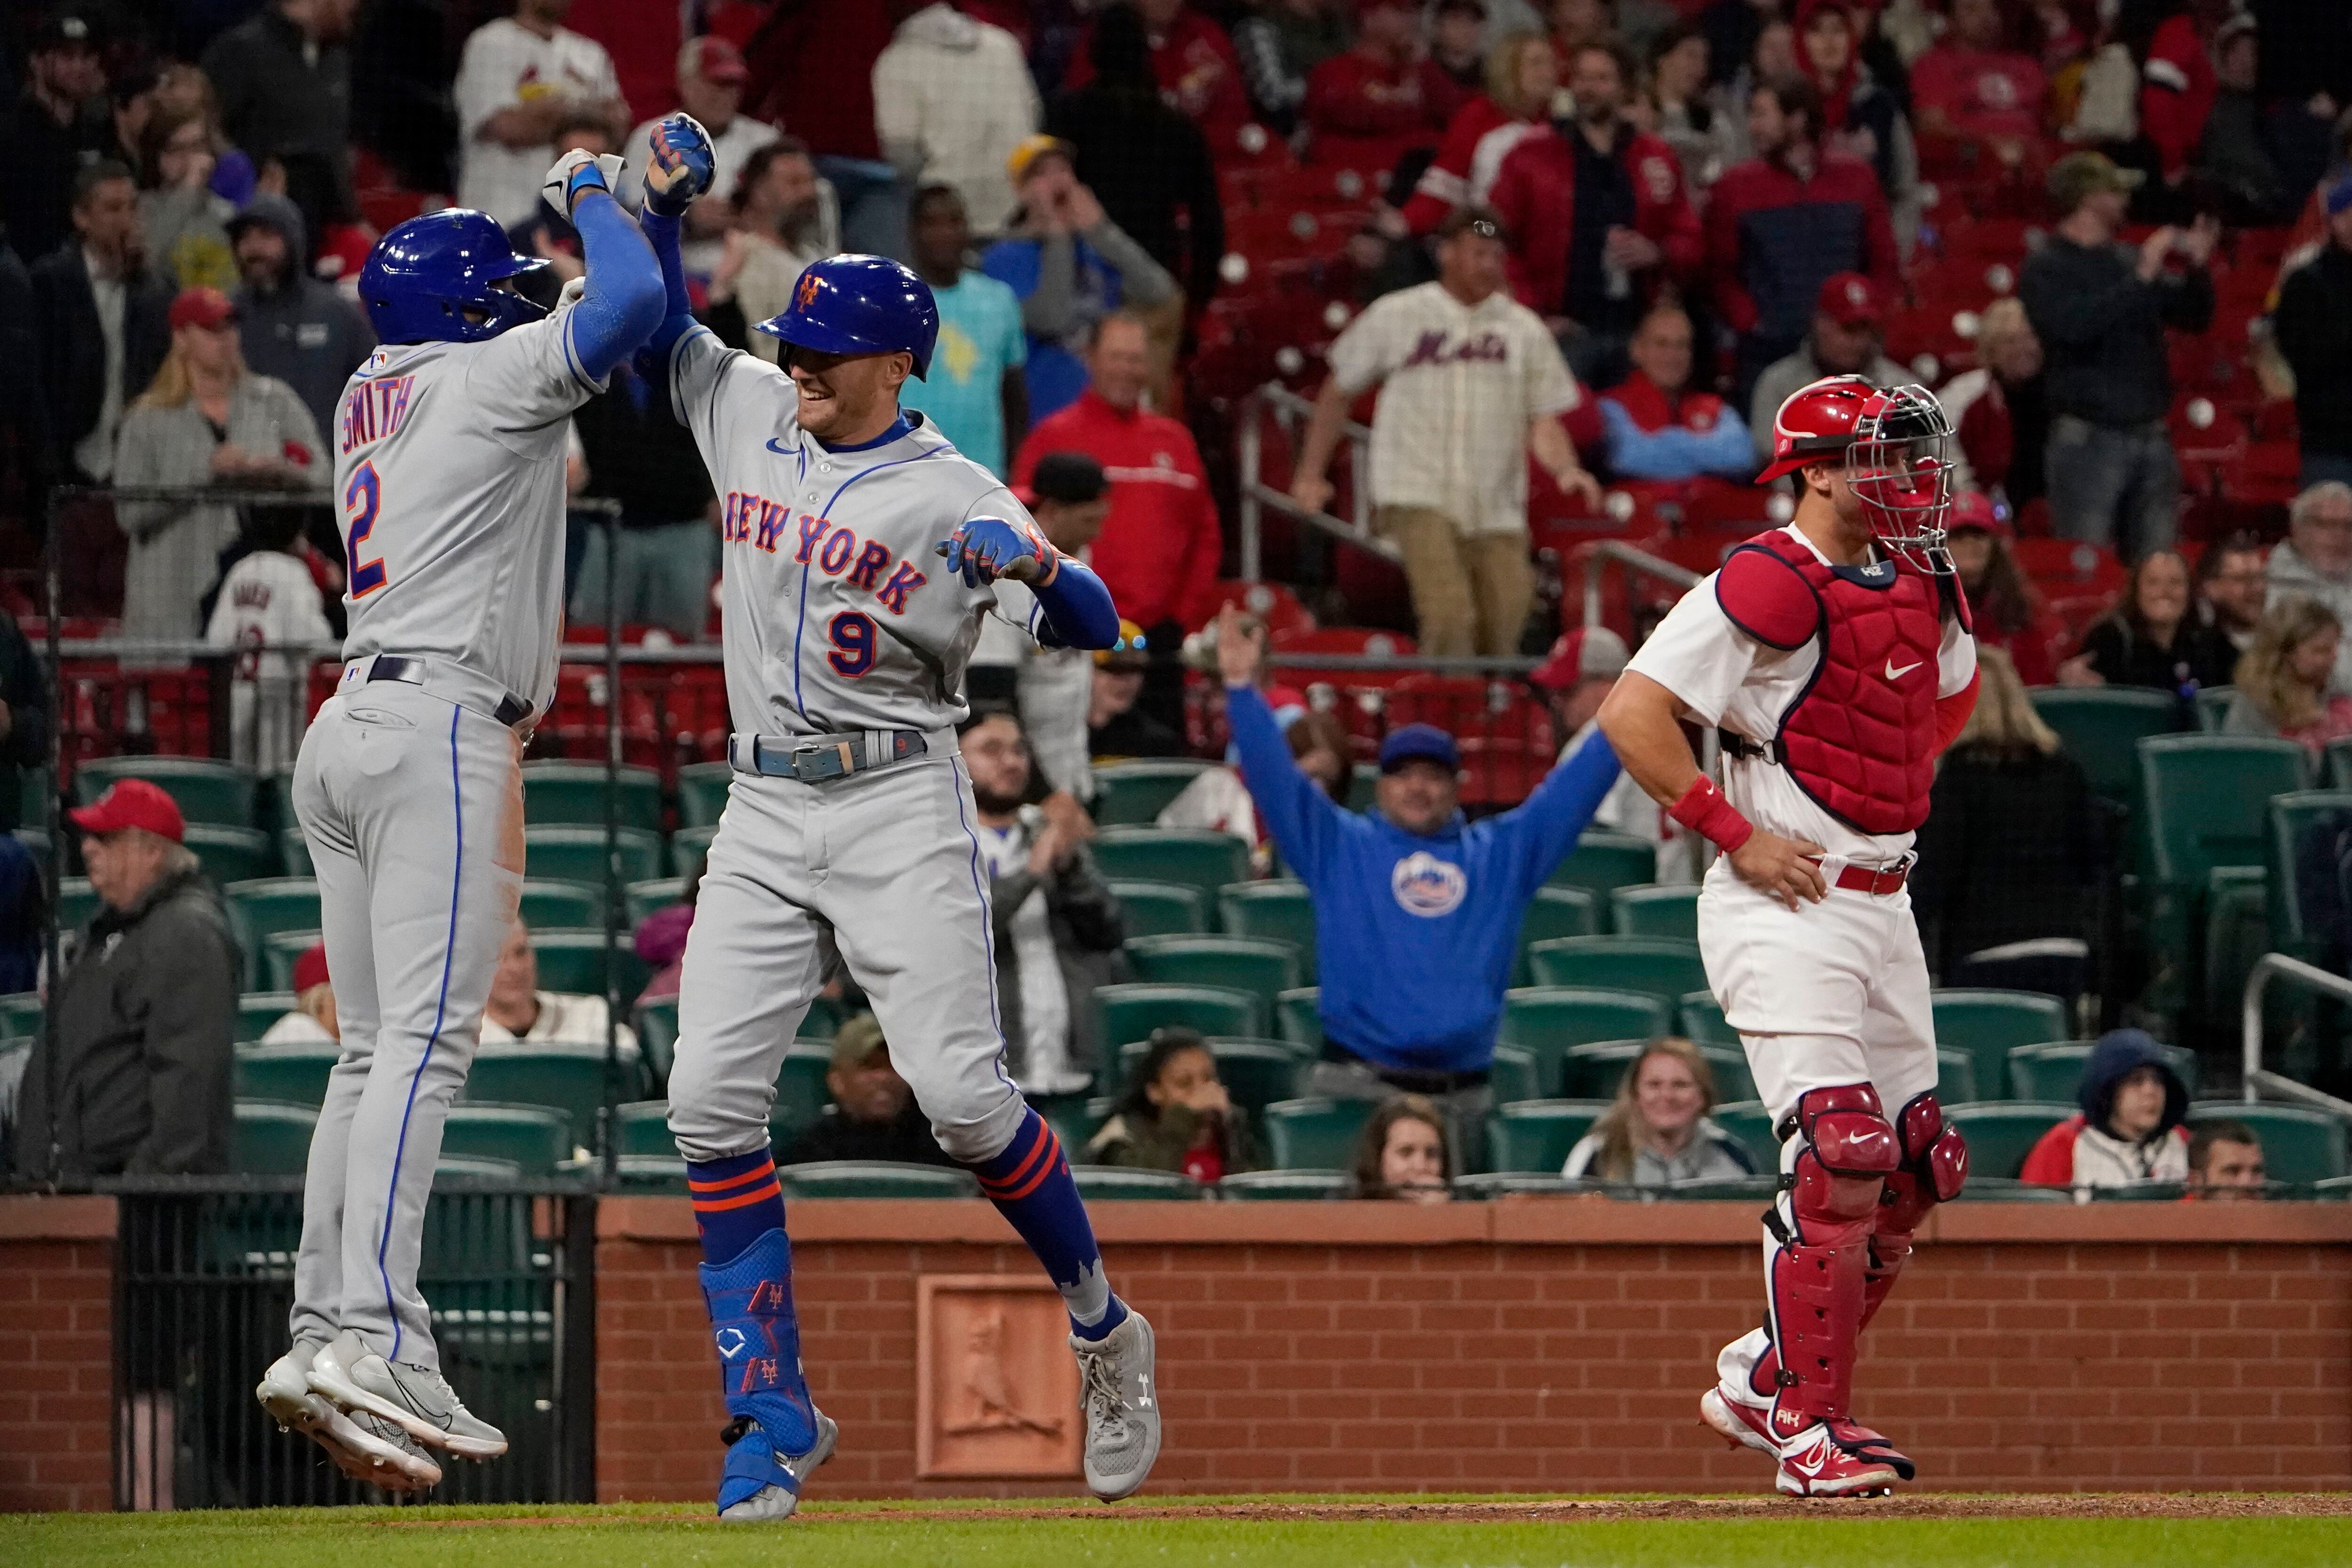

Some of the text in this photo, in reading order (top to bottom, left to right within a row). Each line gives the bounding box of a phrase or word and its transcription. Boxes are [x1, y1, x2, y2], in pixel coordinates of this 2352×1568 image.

[342, 375, 416, 455] SMITH
[346, 459, 388, 600] 2
[795, 514, 928, 615] YORK
[827, 611, 877, 678] 9
